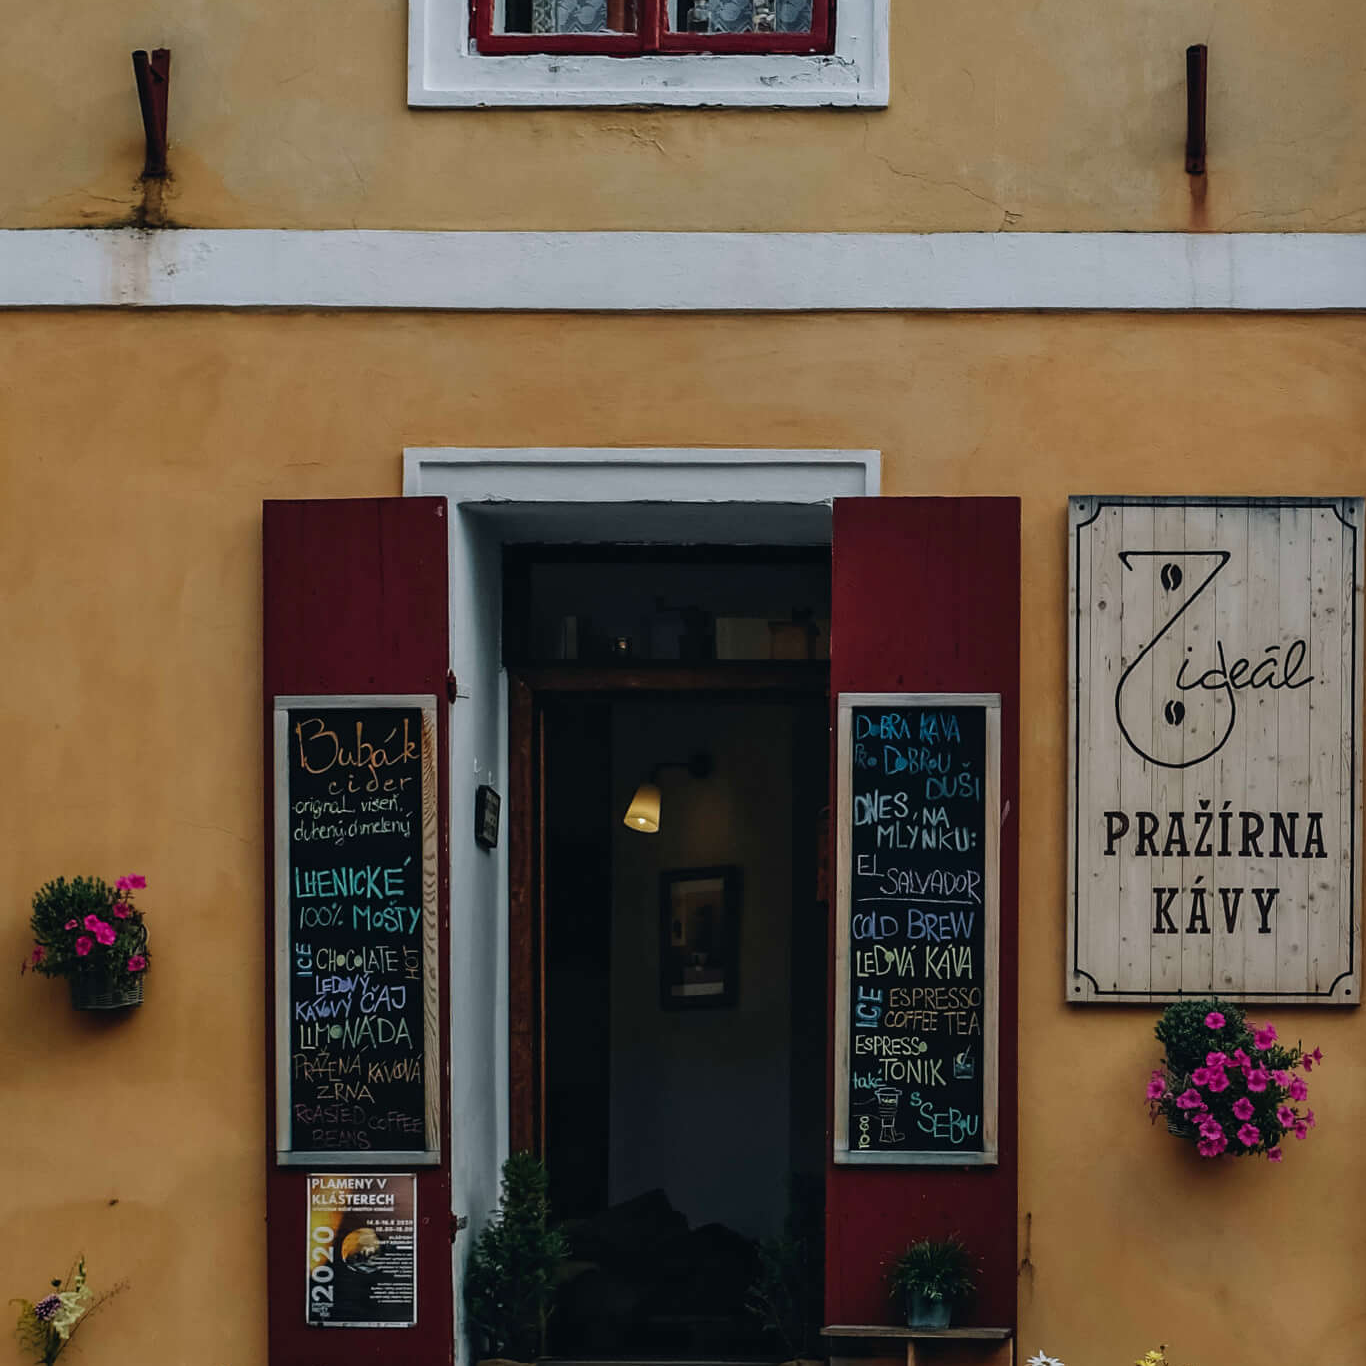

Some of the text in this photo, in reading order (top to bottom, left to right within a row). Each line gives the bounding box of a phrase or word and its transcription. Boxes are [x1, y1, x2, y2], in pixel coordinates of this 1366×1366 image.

[295, 718, 420, 774] Bubák
[883, 744, 951, 776] DOBROU
[328, 765, 413, 796] cider
[926, 761, 980, 803] DUŠI
[922, 806, 950, 829] NA
[1103, 799, 1328, 858] PRAŽÍRNA
[294, 856, 411, 899] LHENICKÉ
[857, 853, 885, 877] EL
[879, 867, 982, 904] SALVADOR
[299, 902, 344, 931] 100%
[1152, 875, 1280, 934] KÁVY
[852, 909, 976, 943] COLD BREW
[295, 942, 313, 977] ICE
[315, 945, 400, 975] CHOCOLATE
[402, 944, 420, 980] HOT
[925, 943, 974, 980] KÁVA
[359, 984, 407, 1014] ČAJ
[855, 985, 883, 1028] ICE
[889, 986, 981, 1010] ESPRESSO
[299, 1015, 414, 1050] LIMONÁDA
[884, 1010, 981, 1036] COFFEE TEA
[855, 1034, 928, 1056] ESPRESSO
[878, 1058, 947, 1087] TONIK
[316, 1081, 376, 1104] ZRNA
[294, 1103, 423, 1133] ROASTED COFFEE
[311, 1128, 373, 1150] BEANS
[311, 1178, 388, 1190] PLAMENY V
[311, 1190, 396, 1206] KLÁŠTERECH
[311, 1226, 335, 1303] 2020
